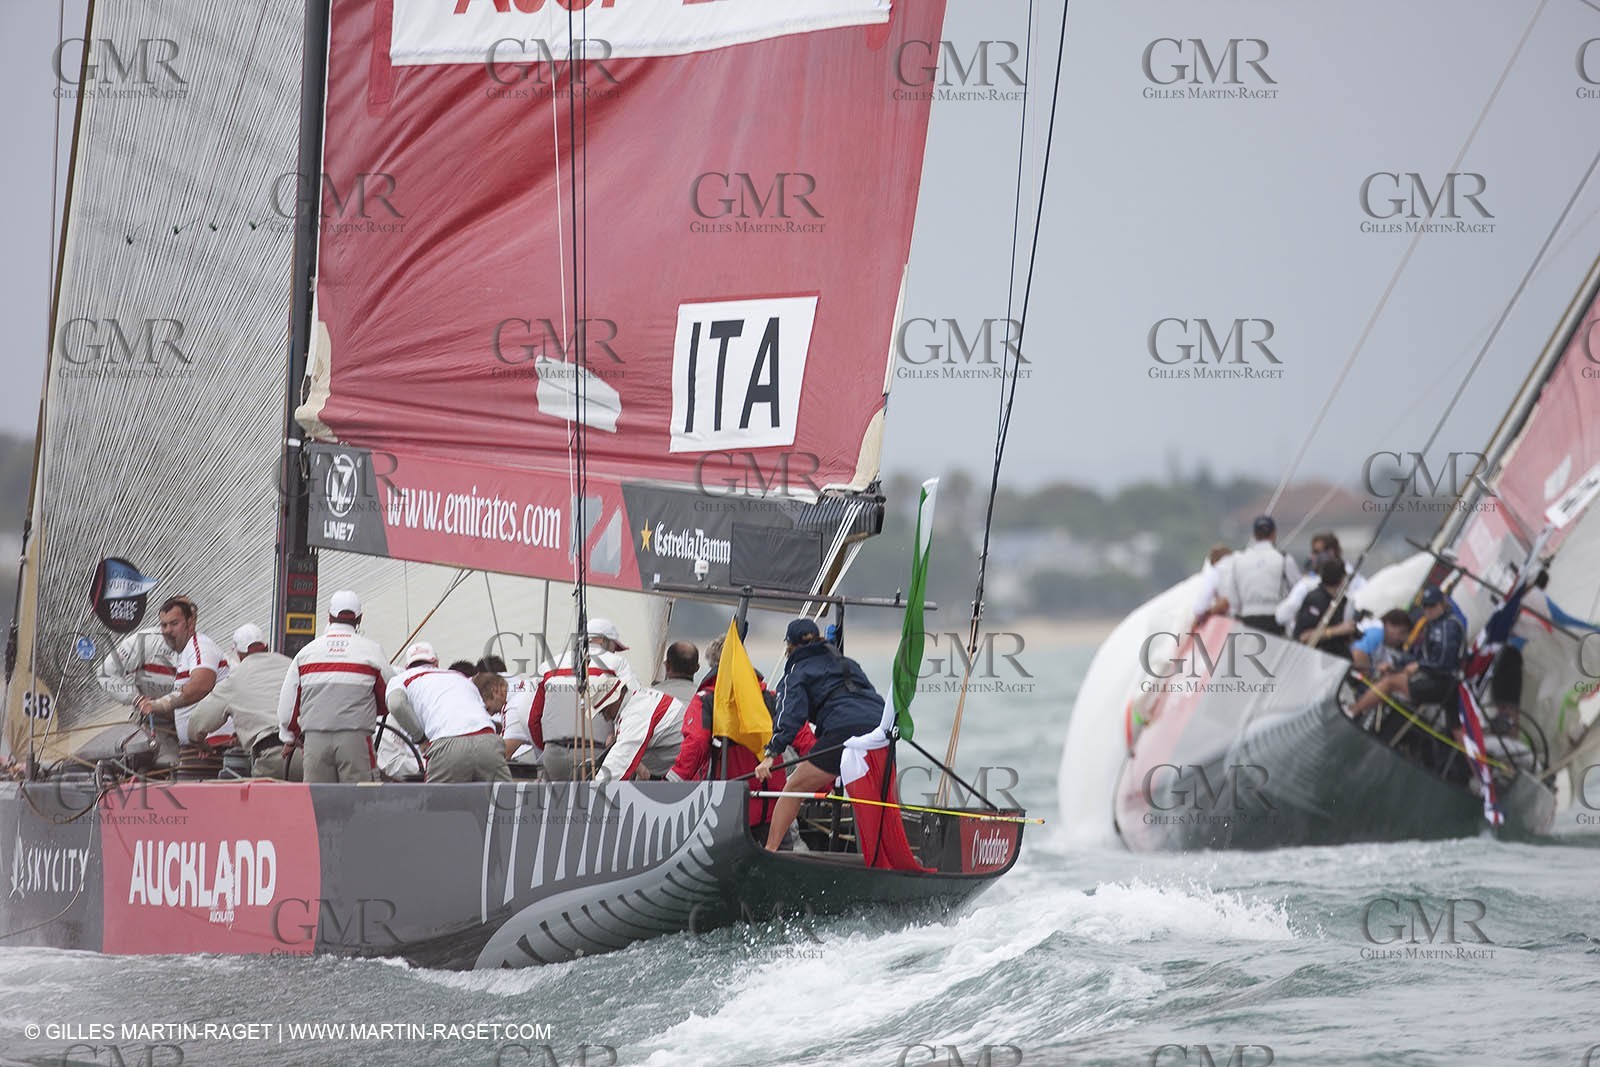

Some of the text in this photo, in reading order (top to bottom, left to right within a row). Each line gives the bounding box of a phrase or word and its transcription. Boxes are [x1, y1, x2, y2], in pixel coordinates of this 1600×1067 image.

[684, 317, 780, 433] ITA
[387, 485, 561, 549] www.emirates.com
[26, 847, 91, 893] SKYCITY
[128, 840, 277, 907] AUCKLAND
